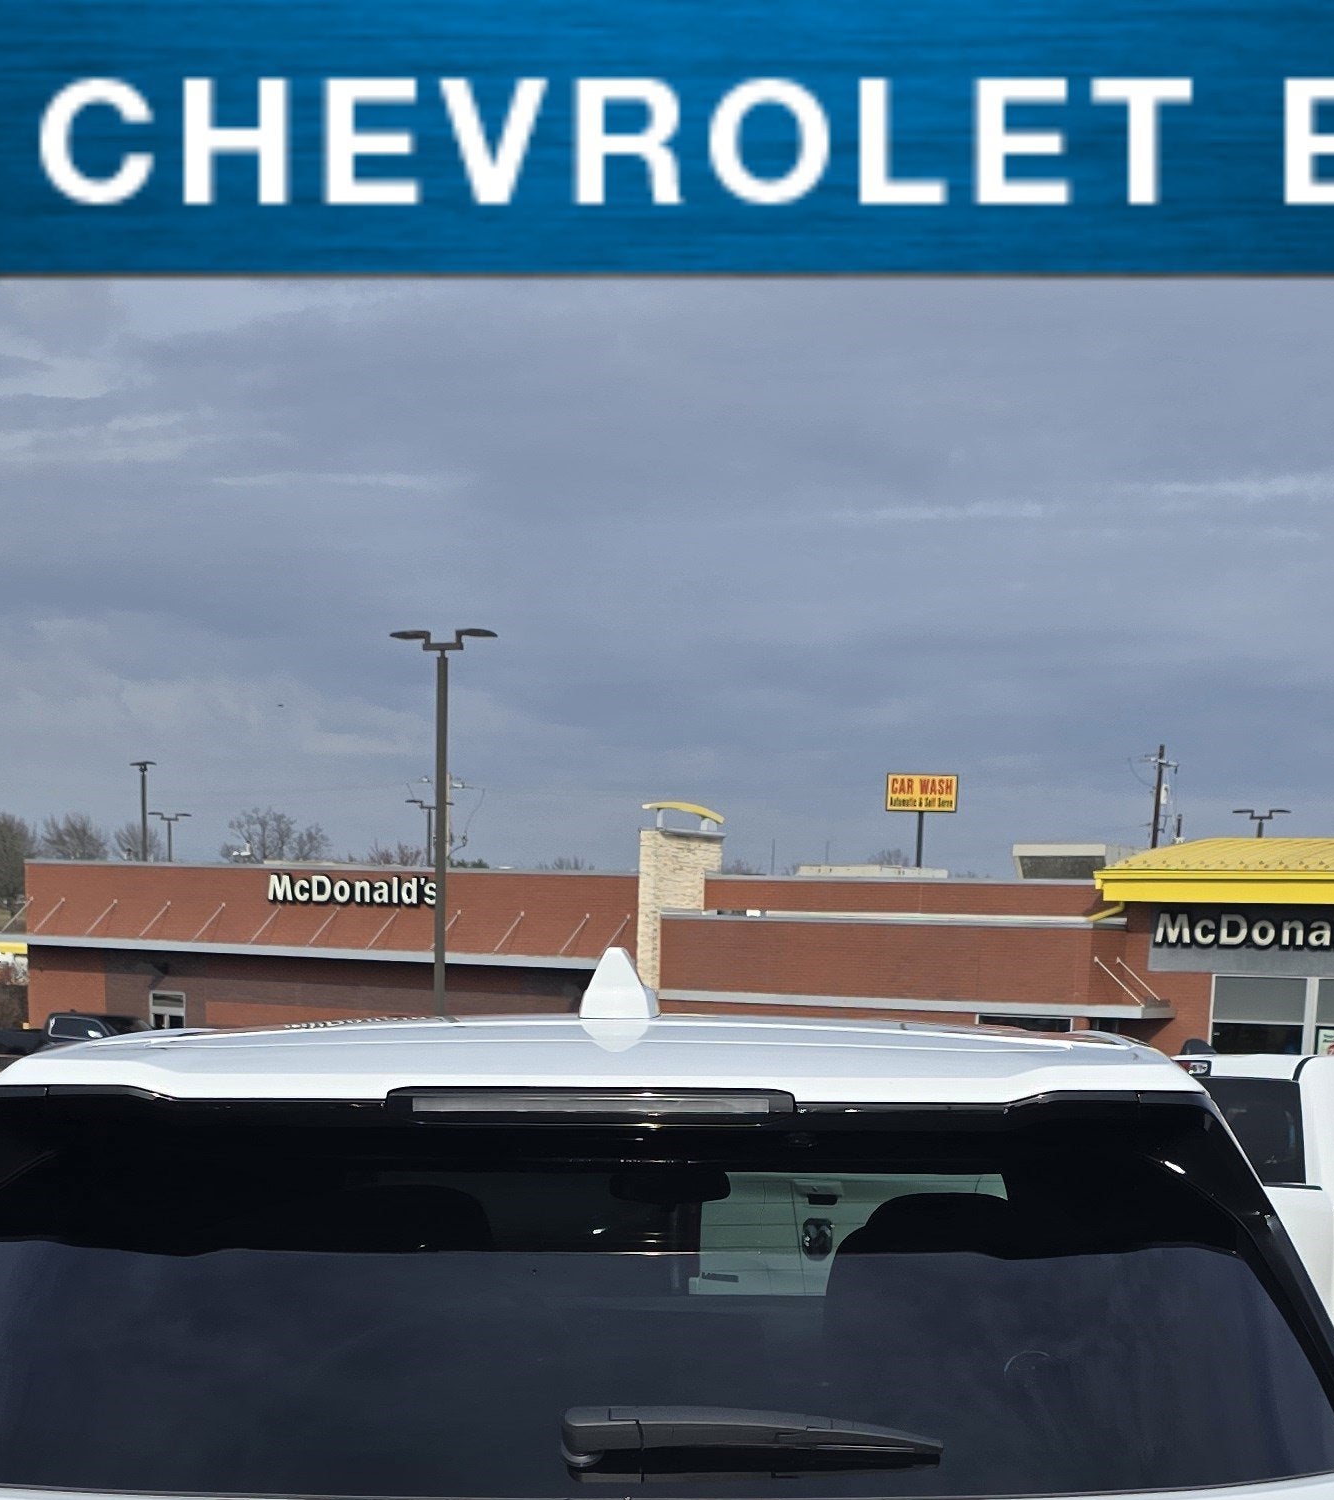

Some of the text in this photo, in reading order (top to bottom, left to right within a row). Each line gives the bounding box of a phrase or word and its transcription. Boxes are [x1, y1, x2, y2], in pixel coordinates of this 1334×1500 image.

[891, 778, 953, 796] CAR WASH
[267, 873, 437, 906] McDonald's
